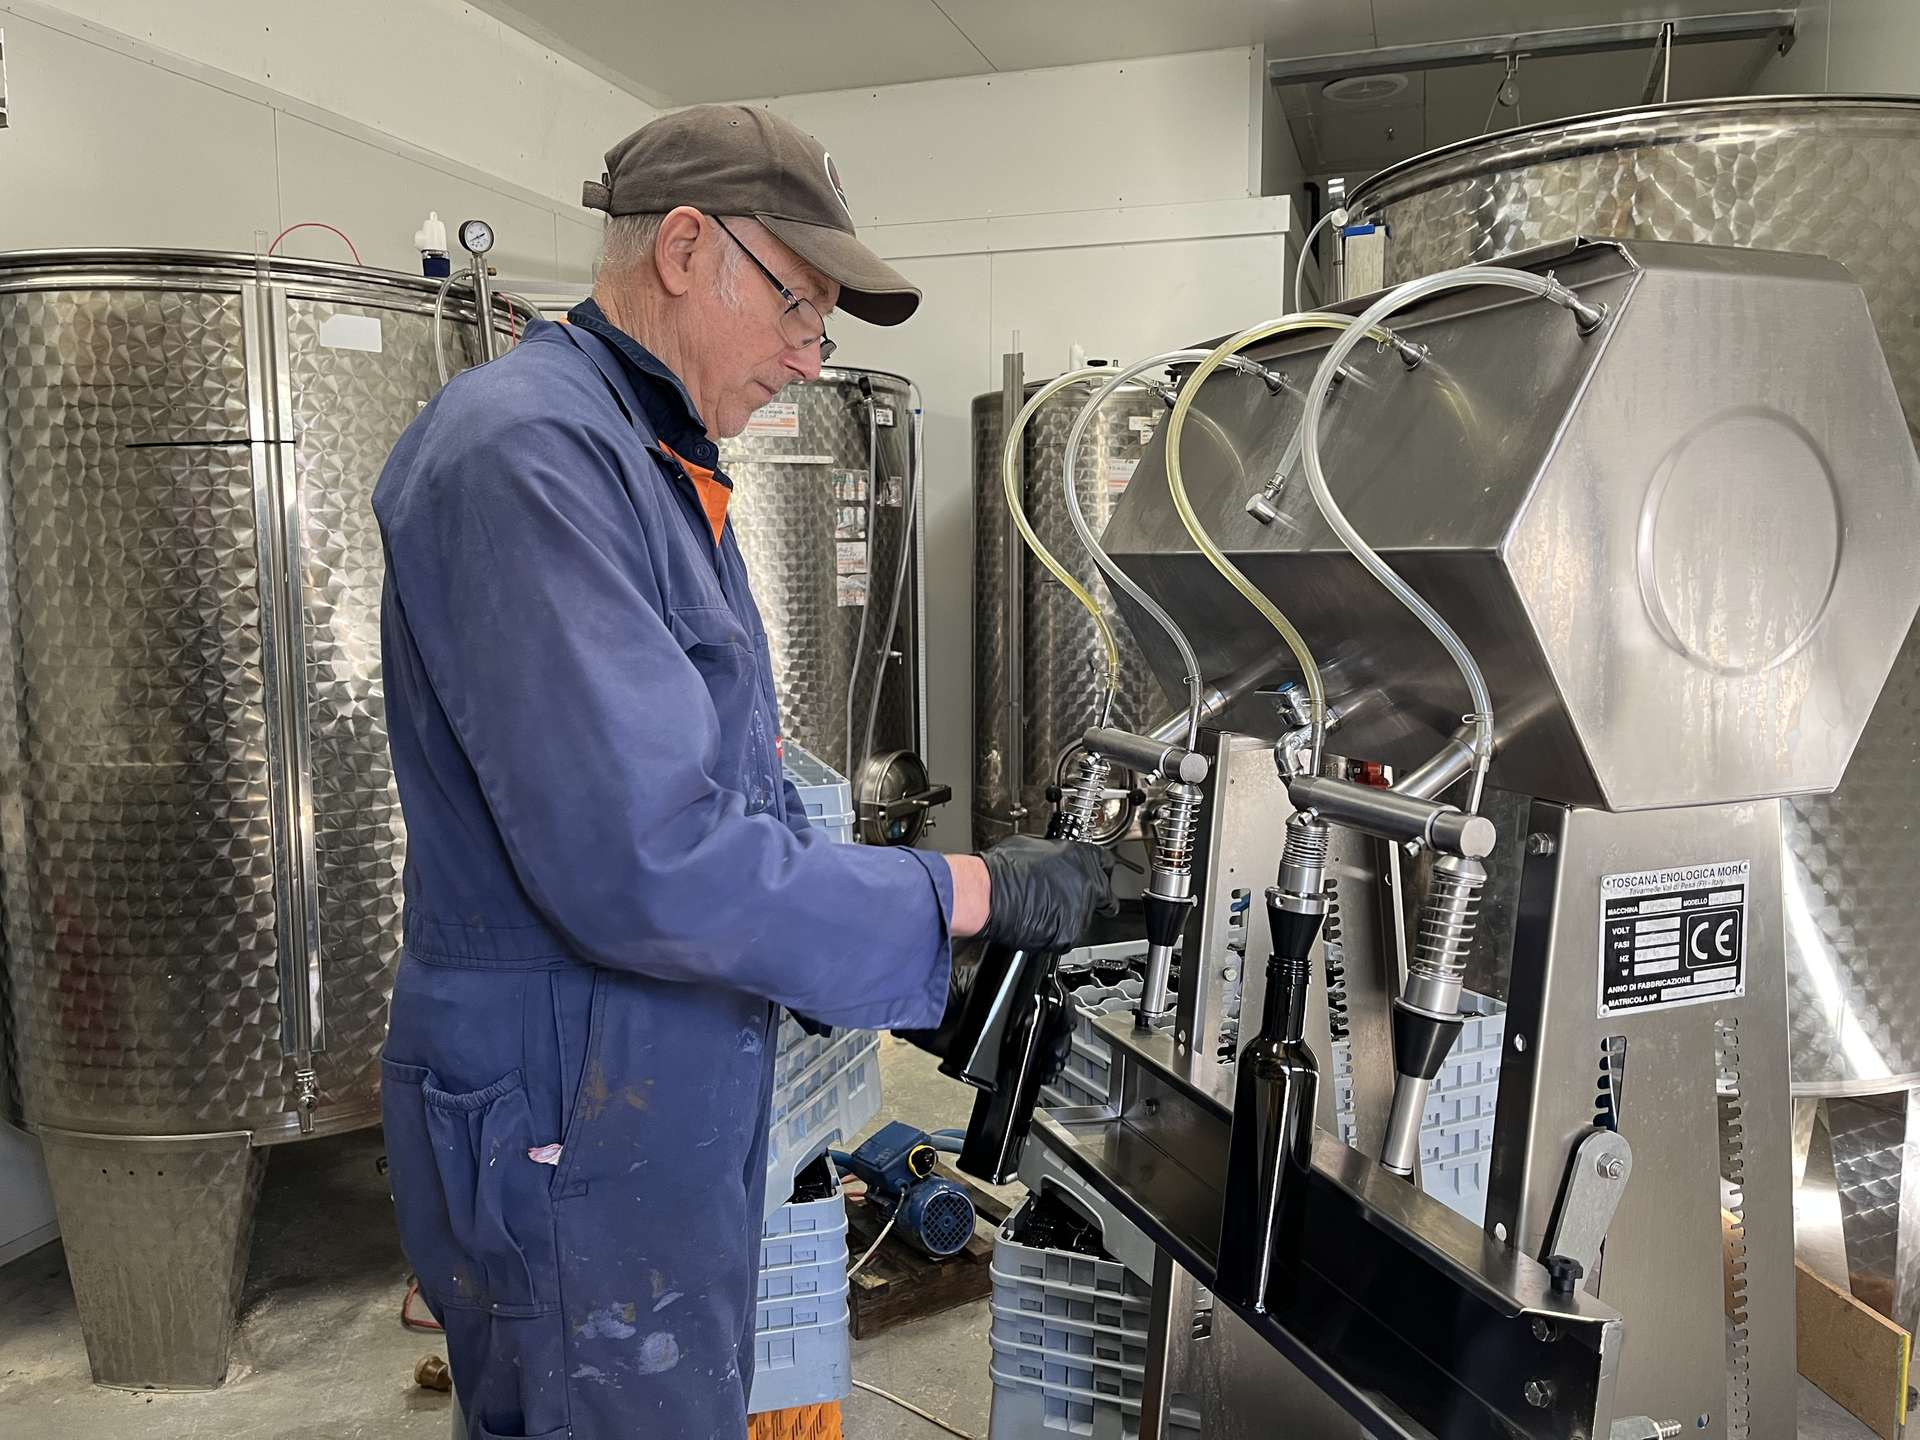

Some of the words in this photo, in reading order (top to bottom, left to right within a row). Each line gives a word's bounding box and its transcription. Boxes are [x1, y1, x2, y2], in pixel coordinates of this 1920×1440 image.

[1612, 875, 1657, 888] TOSCANA
[1661, 868, 1715, 883] ENOLOGICA
[1662, 882, 1673, 892] Val
[1608, 906, 1639, 916] MACCHINA
[1683, 898, 1708, 907] MODELLO
[1612, 926, 1631, 935] VOLT
[1614, 941, 1630, 949] FASI
[1691, 919, 1733, 960] CE
[1619, 955, 1630, 963] HZ
[1608, 984, 1628, 994] ANNO
[1629, 983, 1636, 991] DI
[1637, 976, 1691, 990] FABBRICAZIONE
[1608, 994, 1648, 1007] MATRICOLA
